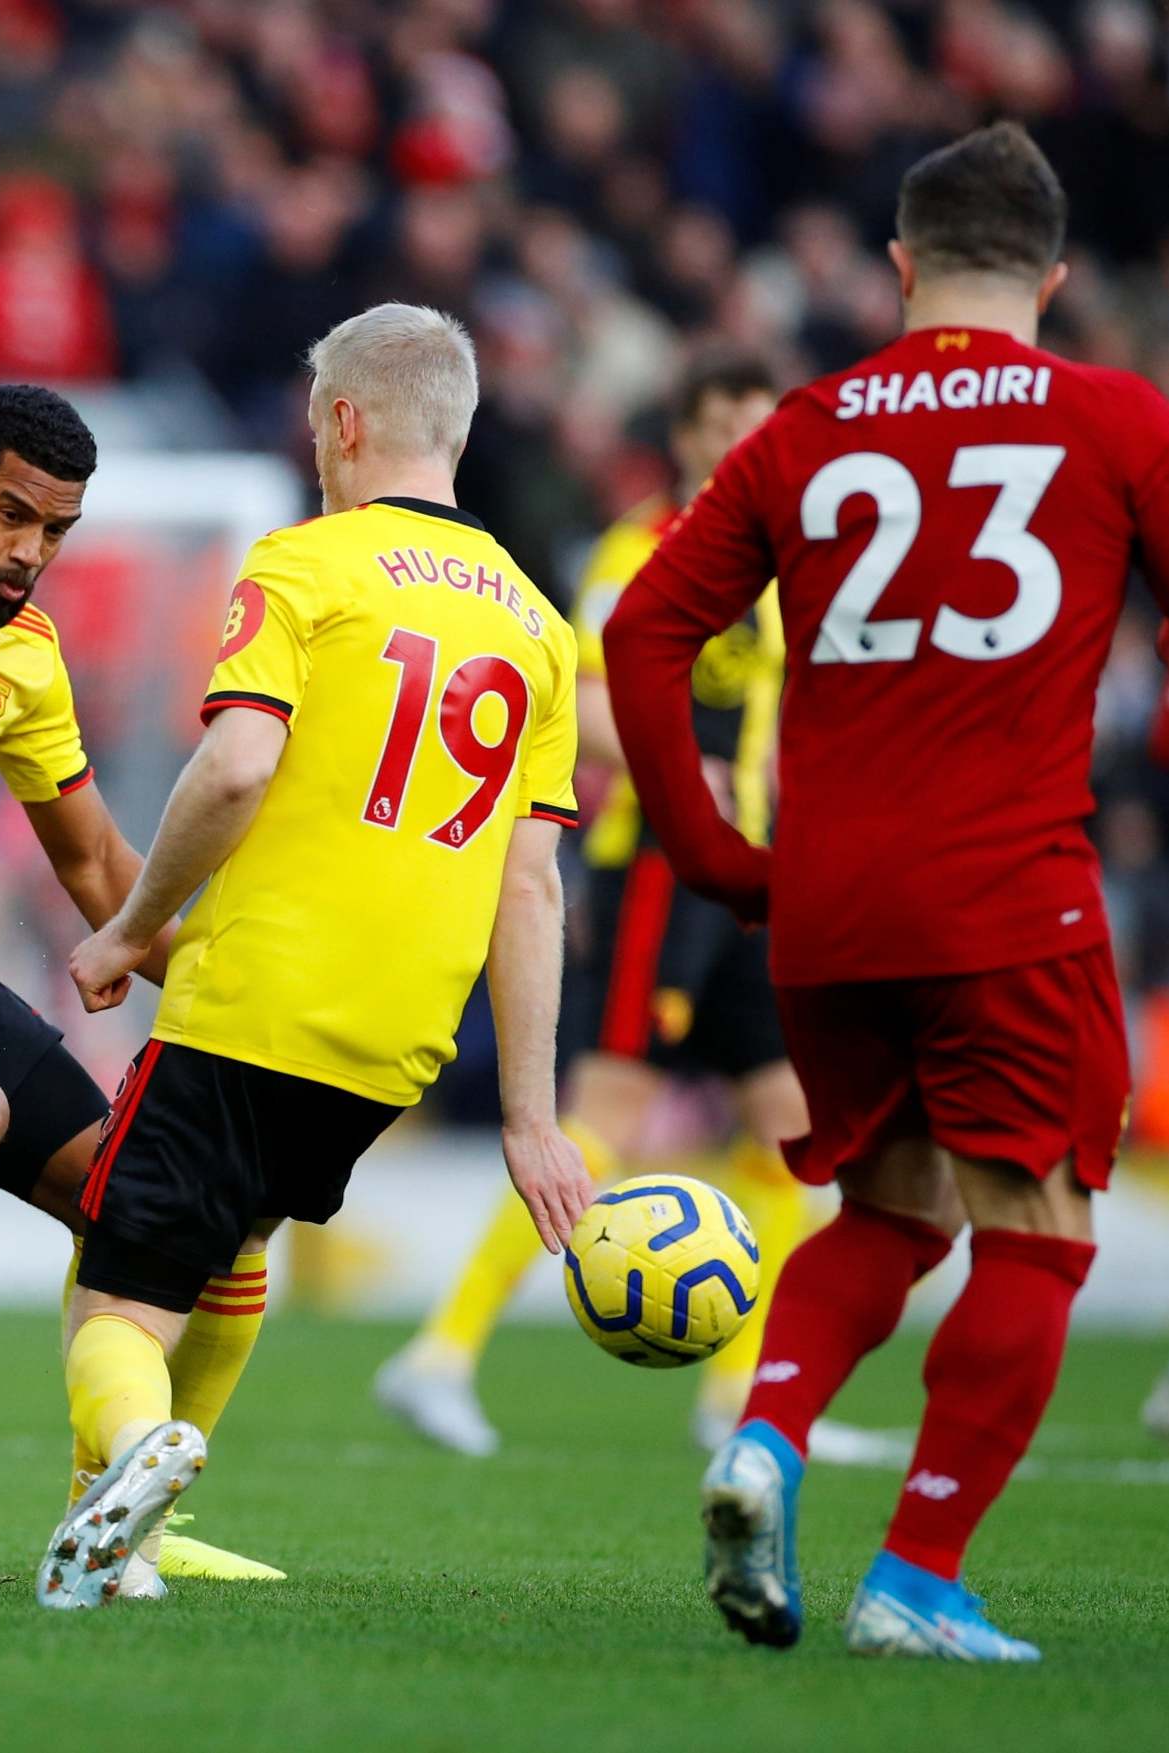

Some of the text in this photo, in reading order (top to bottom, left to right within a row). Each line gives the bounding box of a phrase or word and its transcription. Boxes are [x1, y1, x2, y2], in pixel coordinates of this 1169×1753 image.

[835, 365, 1051, 420] SHAQIRI
[377, 548, 543, 638] HUGHES
[800, 443, 1067, 665] 23
[362, 632, 529, 850] 19
